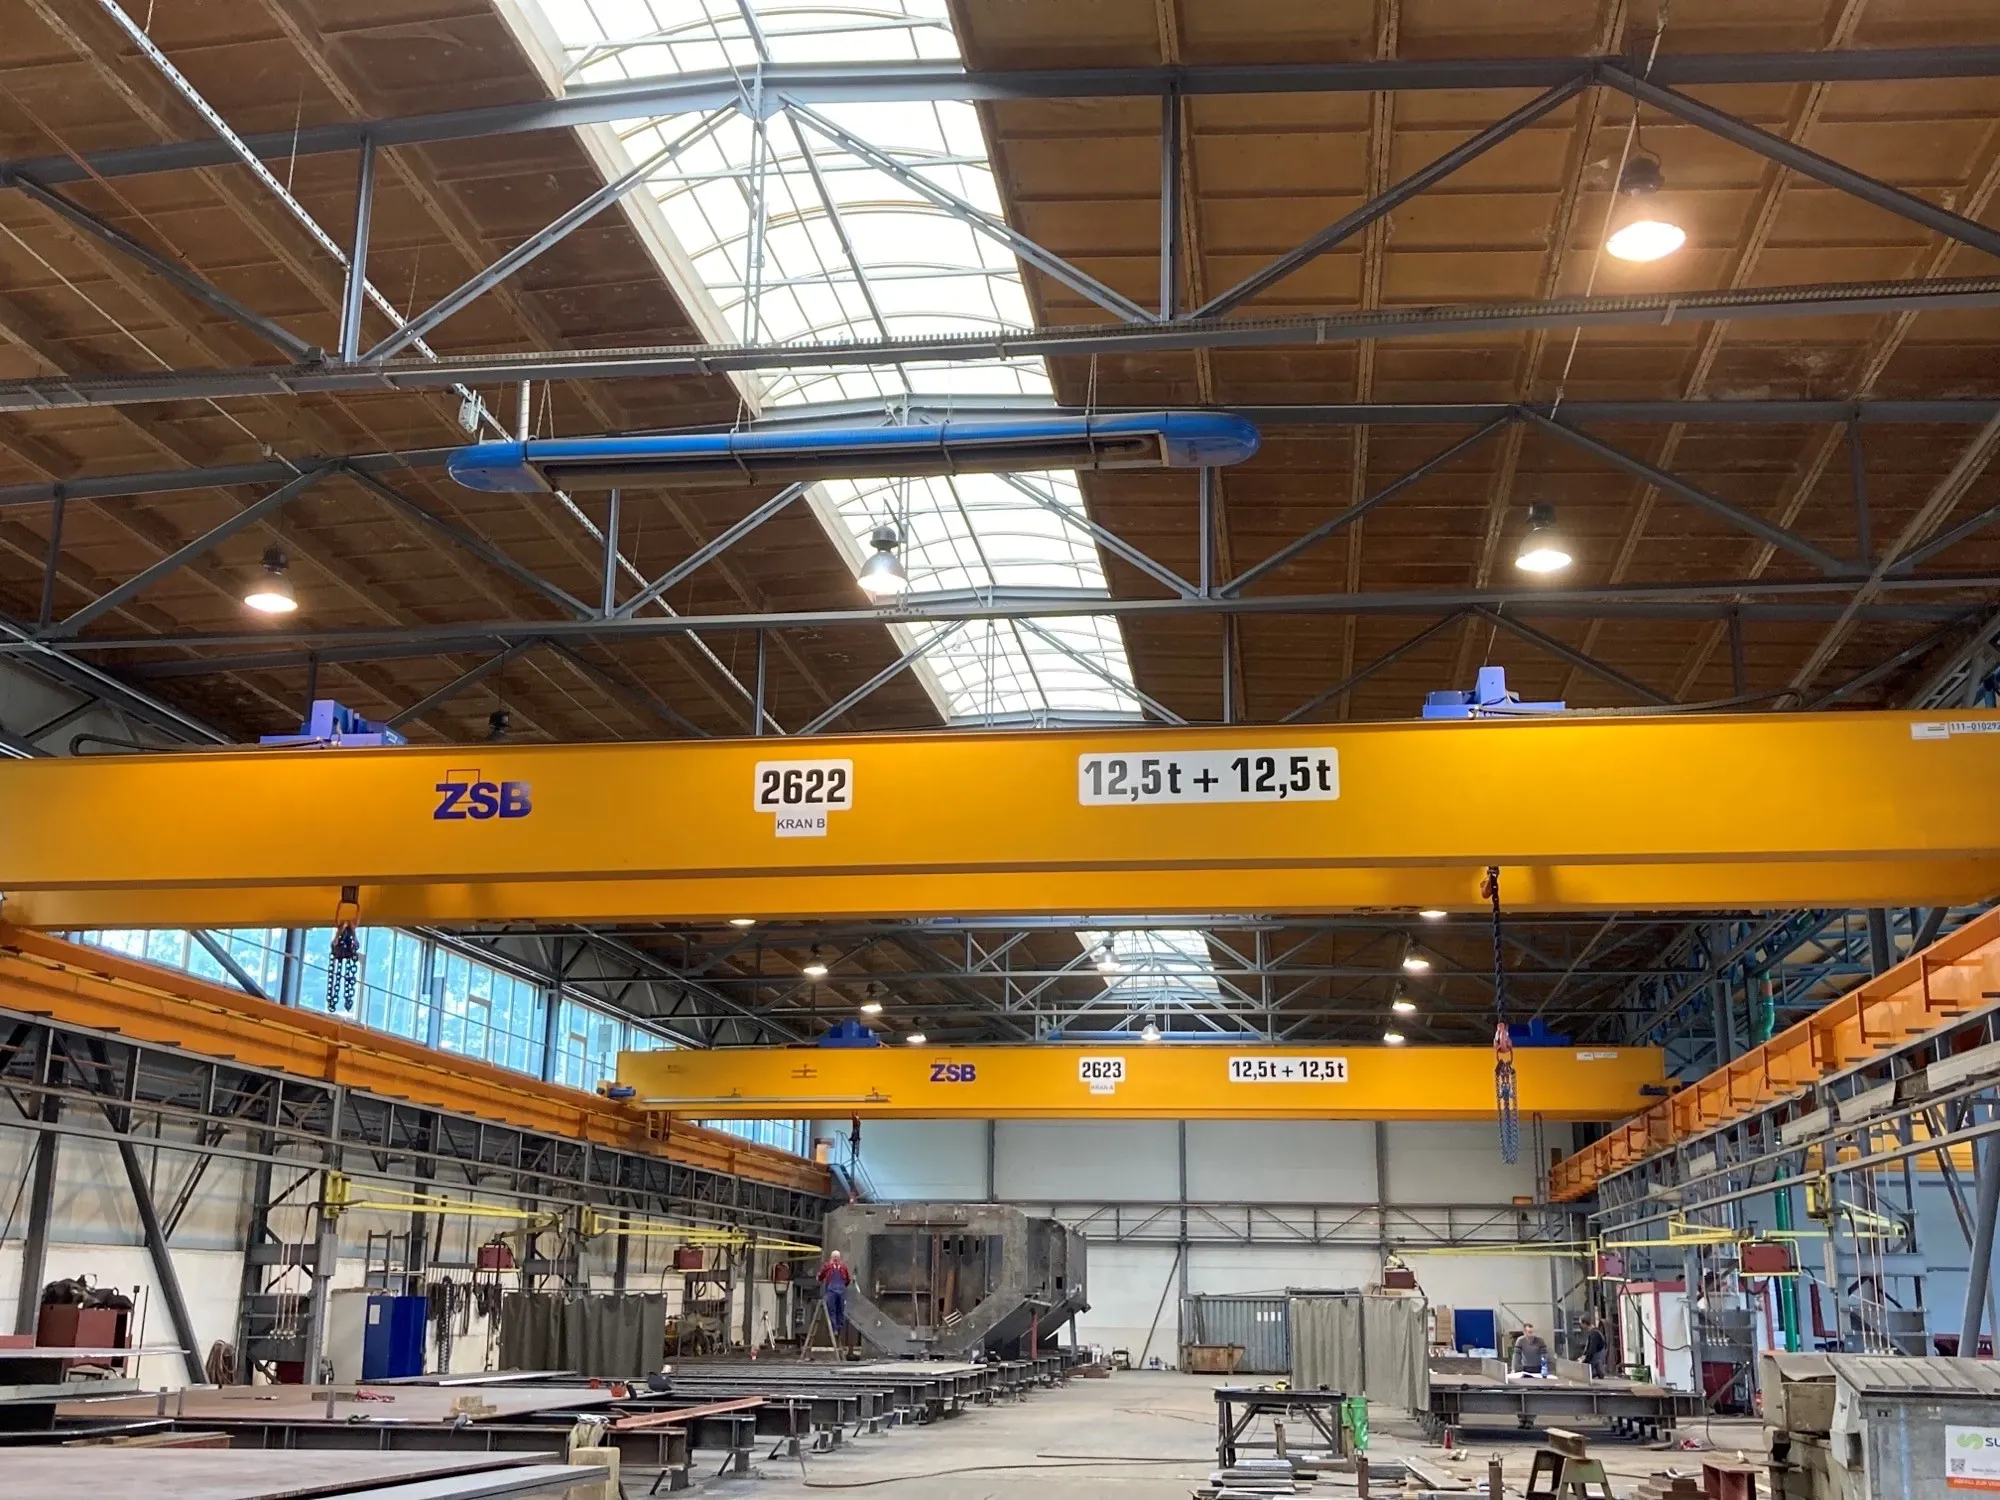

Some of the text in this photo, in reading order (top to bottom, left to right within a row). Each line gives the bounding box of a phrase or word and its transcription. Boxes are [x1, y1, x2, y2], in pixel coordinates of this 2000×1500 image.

[761, 768, 846, 804] 2622
[1084, 756, 1331, 802] 12,5t + 12,5t
[434, 782, 532, 819] ZSB
[777, 818, 825, 829] KRAN B
[930, 1063, 976, 1082] ZSB
[1082, 1061, 1122, 1078] 2623
[1232, 1061, 1343, 1080] 12,5t + 12,5t
